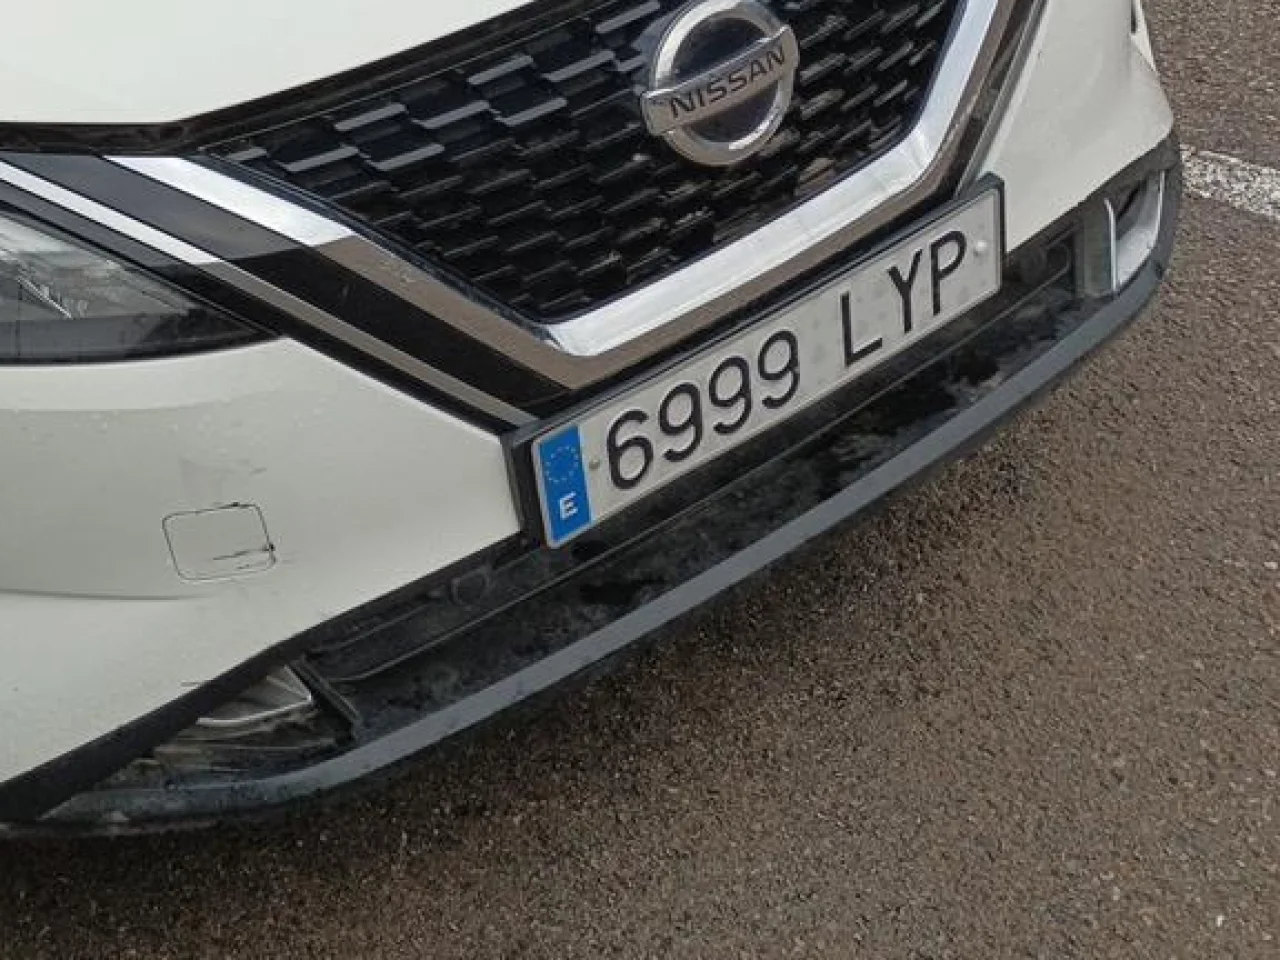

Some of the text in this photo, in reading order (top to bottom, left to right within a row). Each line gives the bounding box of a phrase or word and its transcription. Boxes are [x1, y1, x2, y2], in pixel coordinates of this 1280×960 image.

[669, 44, 786, 118] NISSAN
[606, 230, 968, 490] 6999 LYP
[559, 491, 578, 519] E
